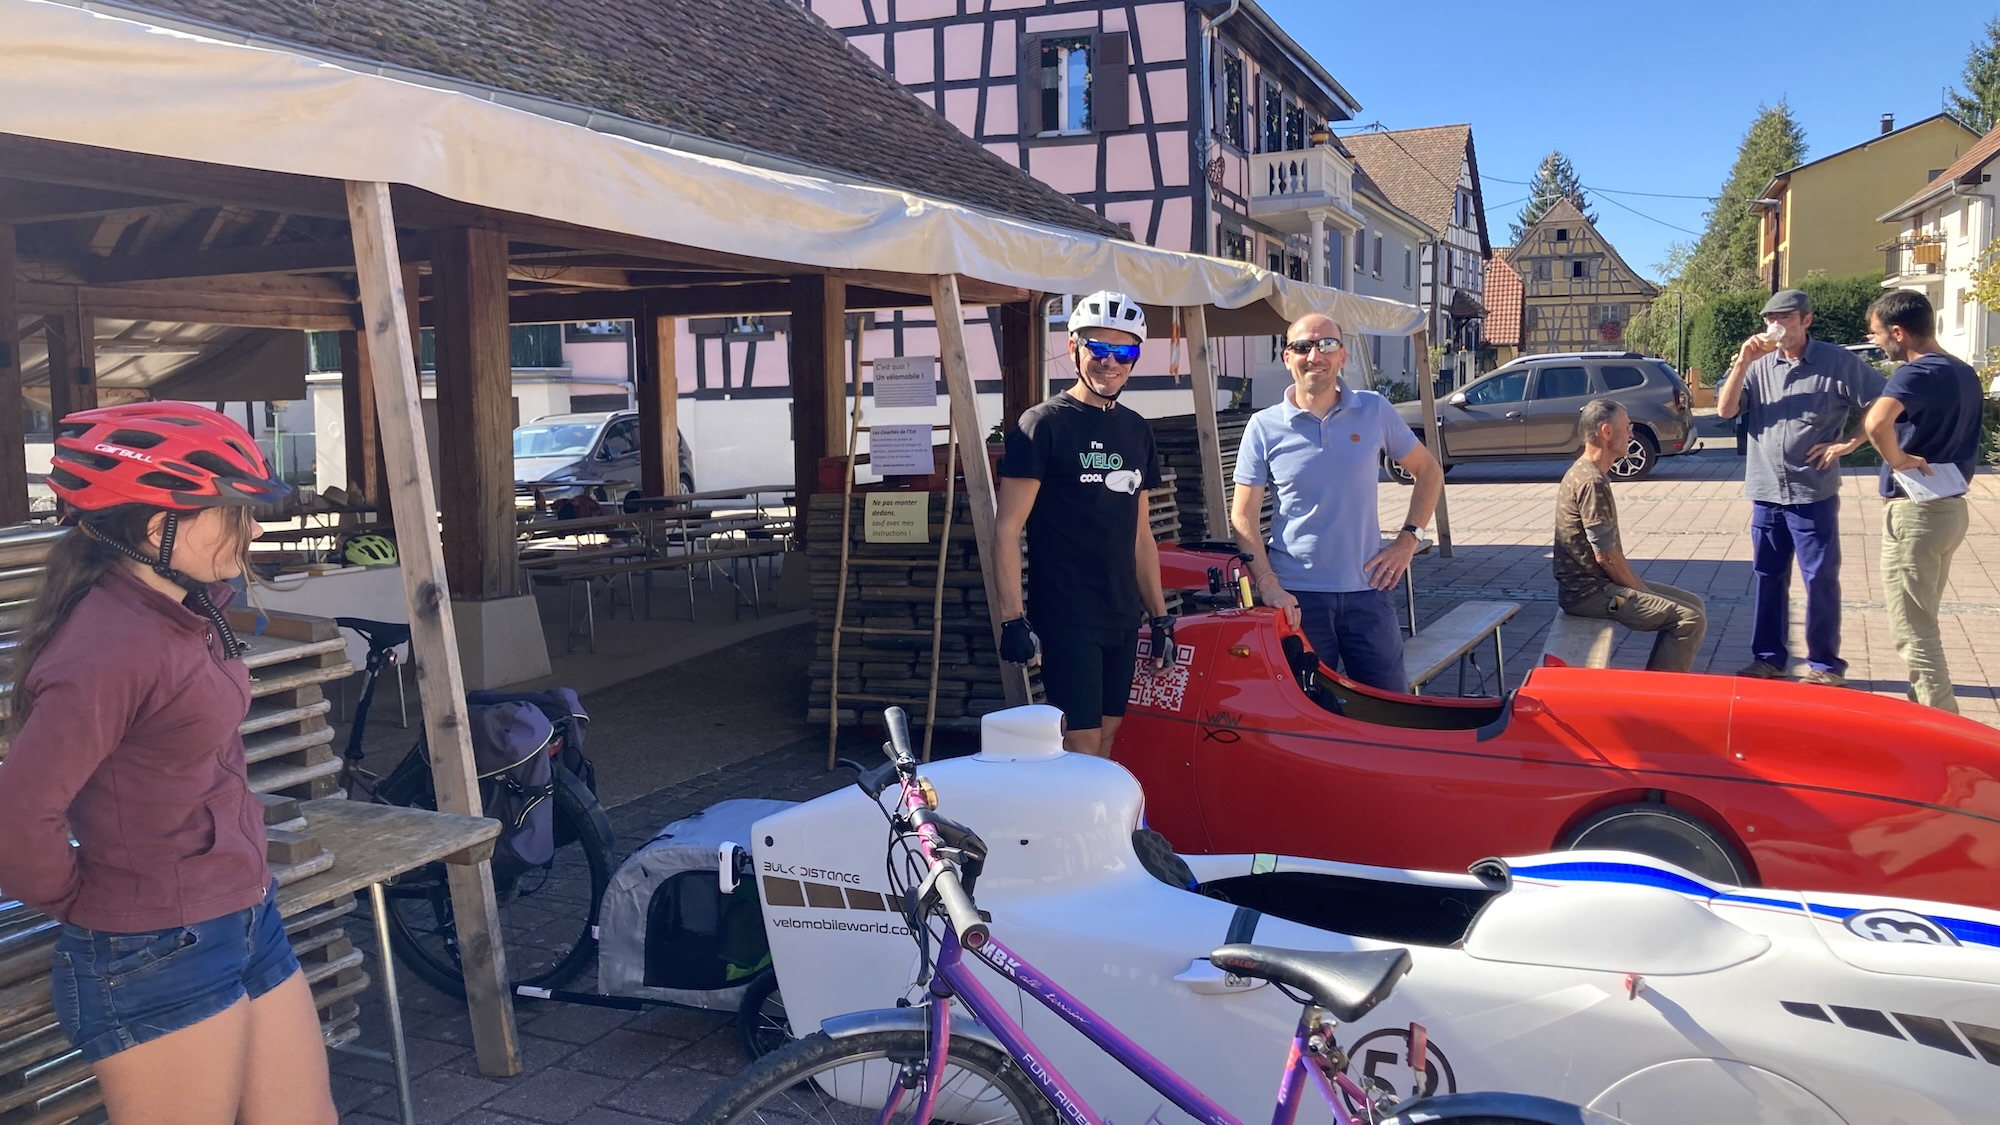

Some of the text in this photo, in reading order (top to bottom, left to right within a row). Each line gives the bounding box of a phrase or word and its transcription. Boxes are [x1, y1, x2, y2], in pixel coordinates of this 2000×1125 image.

[892, 363, 905, 371] quoi
[1091, 440, 1103, 449] I'm
[1079, 452, 1123, 470] VELO
[1080, 473, 1103, 483] COOL
[1205, 709, 1243, 727] WAW
[764, 861, 796, 875] BULK
[979, 941, 1021, 977] MBK
[1043, 993, 1091, 1024] terrain
[1022, 1053, 1092, 1125] FUN RIDE
